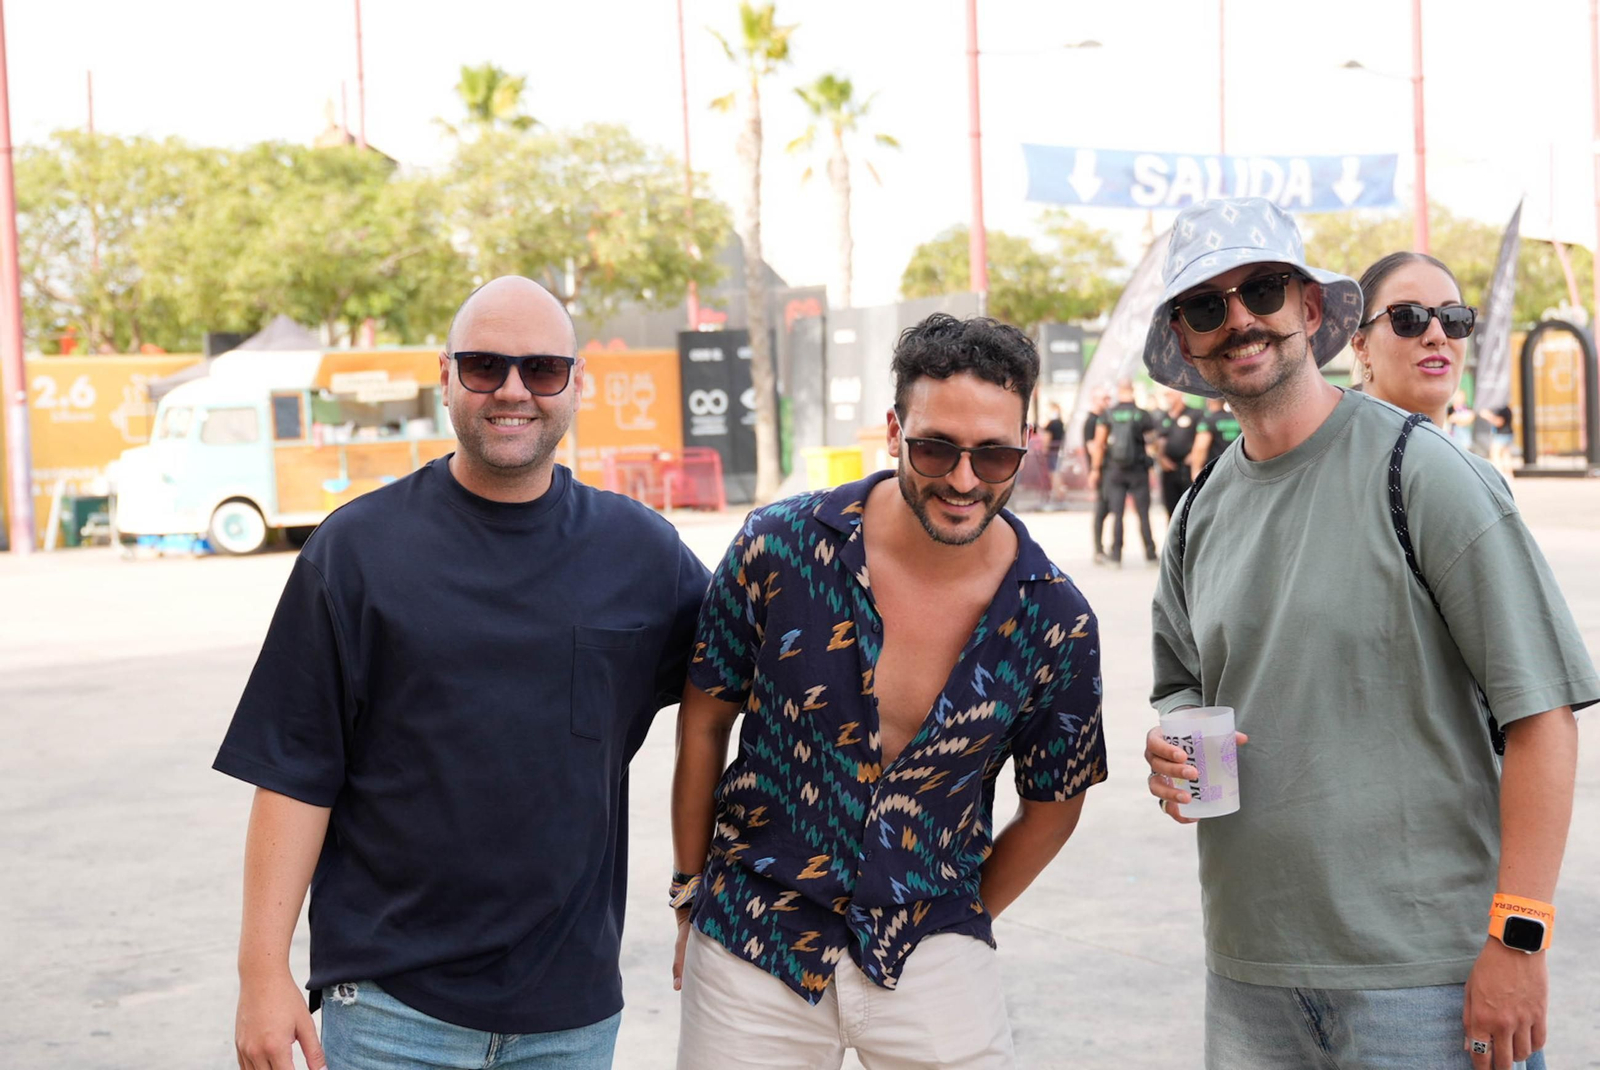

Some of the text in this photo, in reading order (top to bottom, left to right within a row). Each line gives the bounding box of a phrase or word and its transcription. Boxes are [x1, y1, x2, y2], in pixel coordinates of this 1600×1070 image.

[1130, 154, 1312, 206] SALIDA
[32, 375, 96, 408] 2.6
[1494, 902, 1551, 919] LANZADERA
